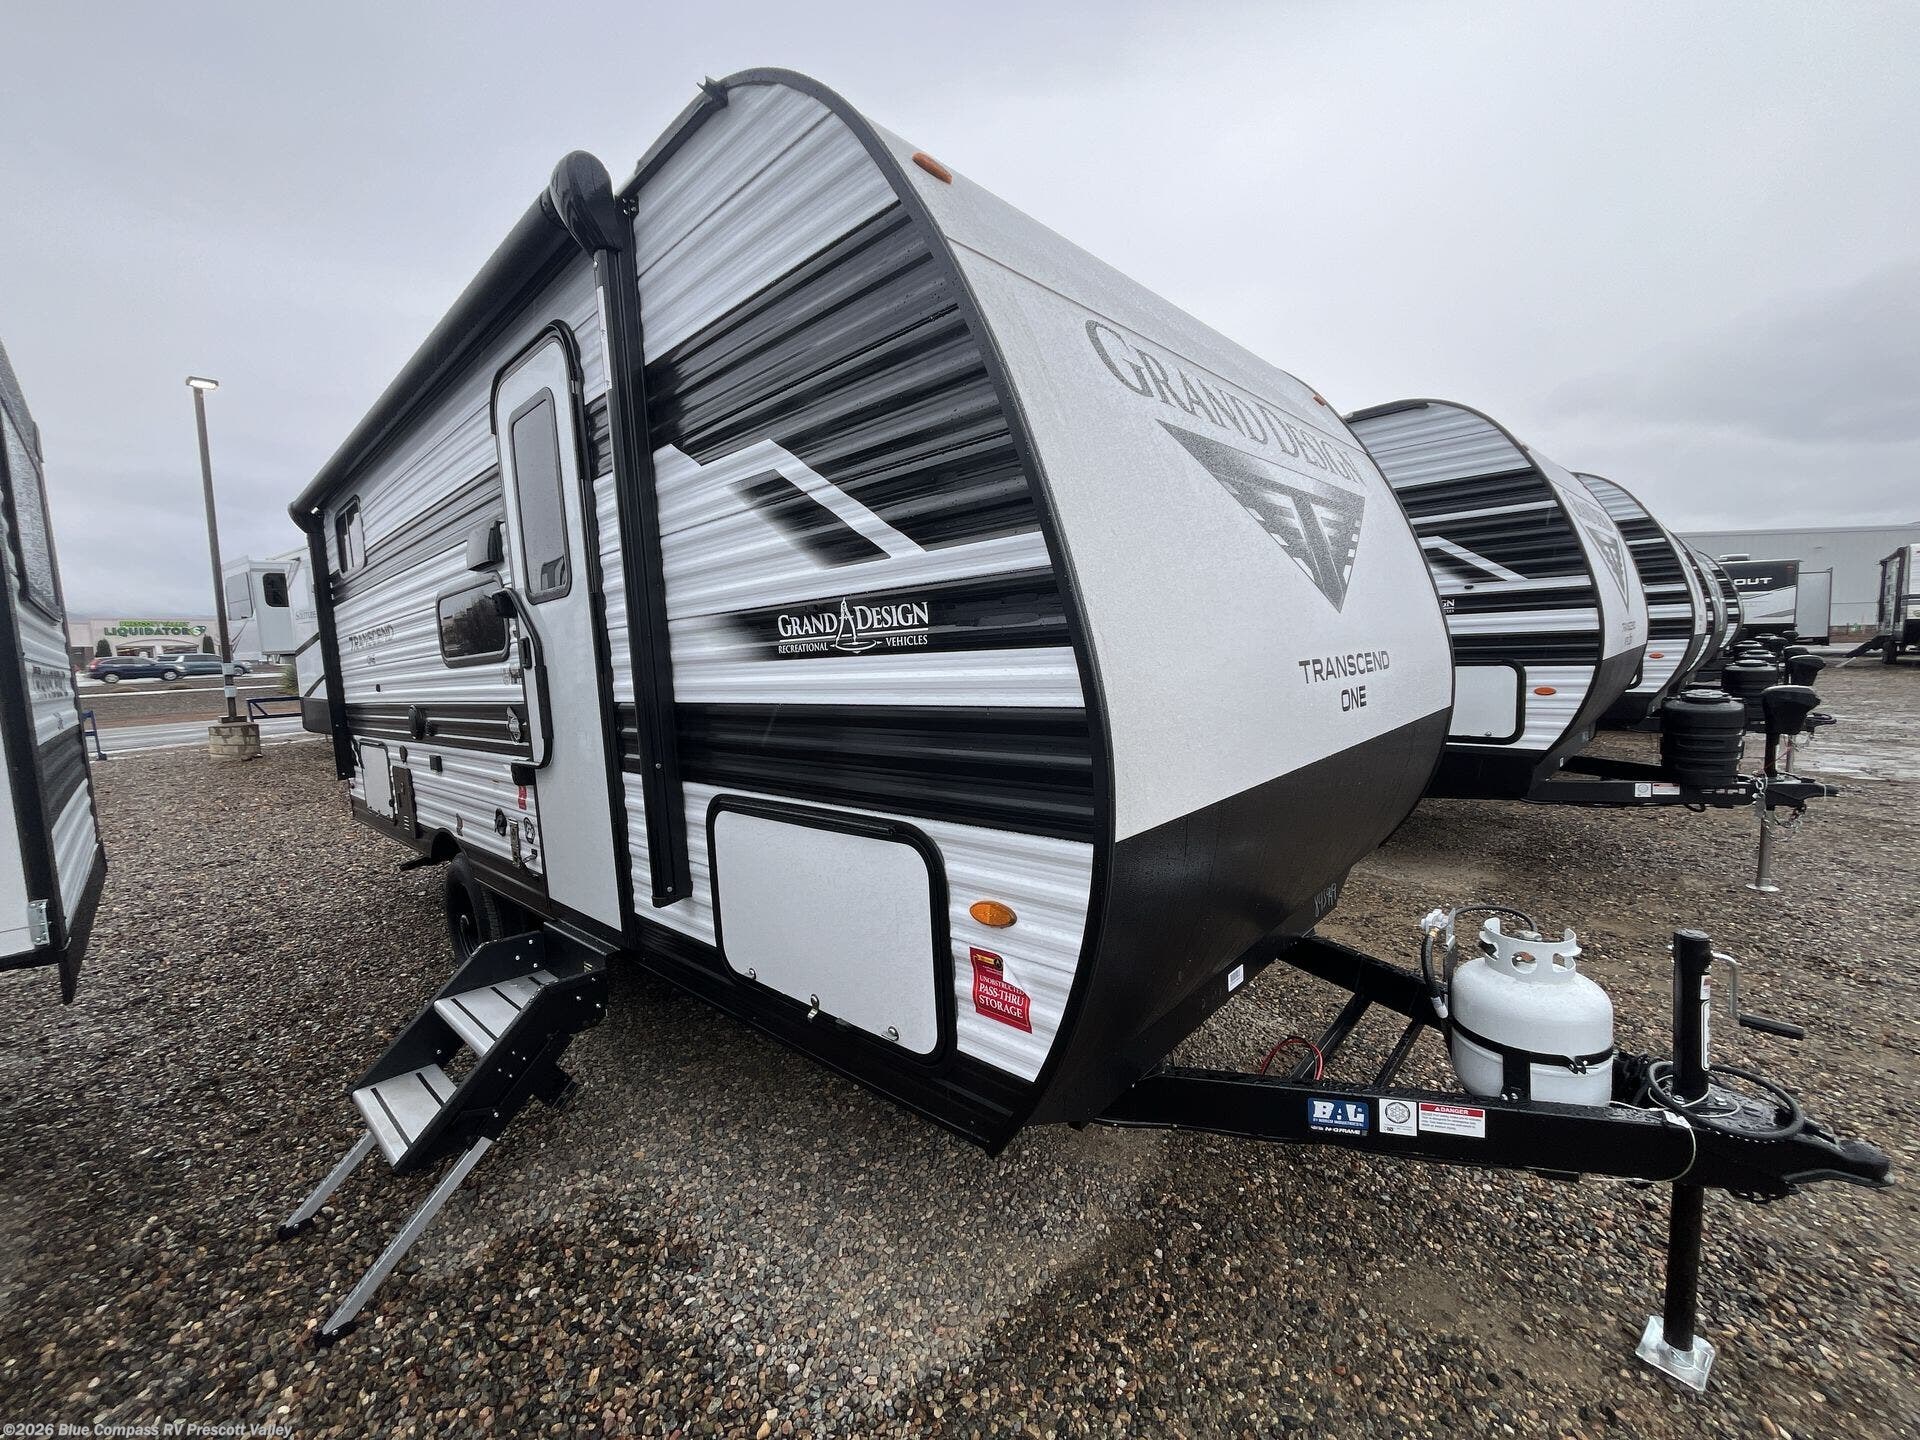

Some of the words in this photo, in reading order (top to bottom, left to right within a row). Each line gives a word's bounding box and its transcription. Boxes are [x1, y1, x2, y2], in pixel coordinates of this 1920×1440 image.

[1085, 319, 1268, 445] GRAND
[1255, 401, 1367, 488] DESIGN
[1733, 577, 1773, 586] OUT
[777, 612, 838, 637] GRAND
[853, 601, 929, 630] DESIGN
[778, 642, 829, 654] RECREATIONAL
[885, 634, 928, 647] VEHICLES
[1298, 650, 1390, 684] TRANSCEND
[1341, 685, 1367, 712] ONE
[979, 983, 1024, 1007] PASS-THRU
[979, 994, 1023, 1019] STORAGE
[1440, 1107, 1469, 1115] DANGER
